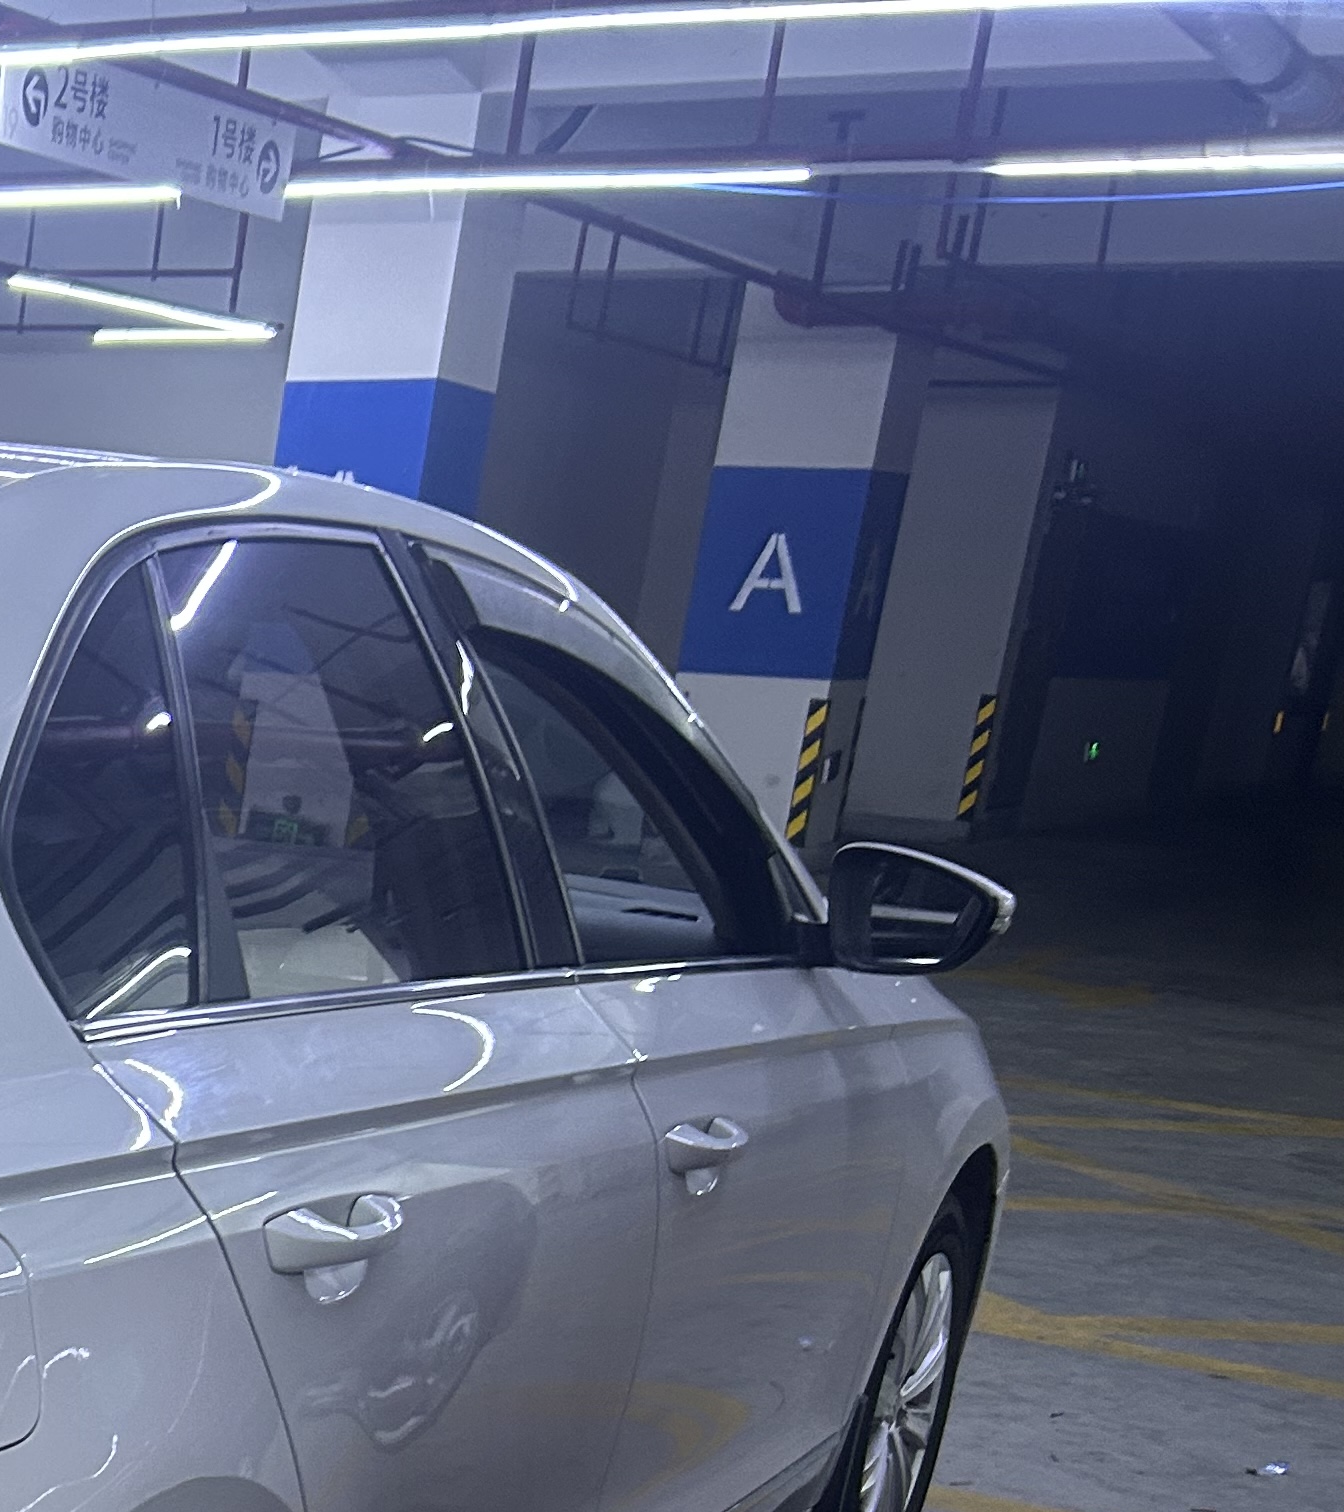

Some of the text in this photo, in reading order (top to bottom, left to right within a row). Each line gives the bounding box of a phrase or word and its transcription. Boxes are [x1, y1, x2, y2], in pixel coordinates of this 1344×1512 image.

[54, 66, 109, 120] 2号楼
[51, 115, 104, 155] 购物中心
[212, 114, 256, 164] 1号楼
[728, 532, 802, 614] A
